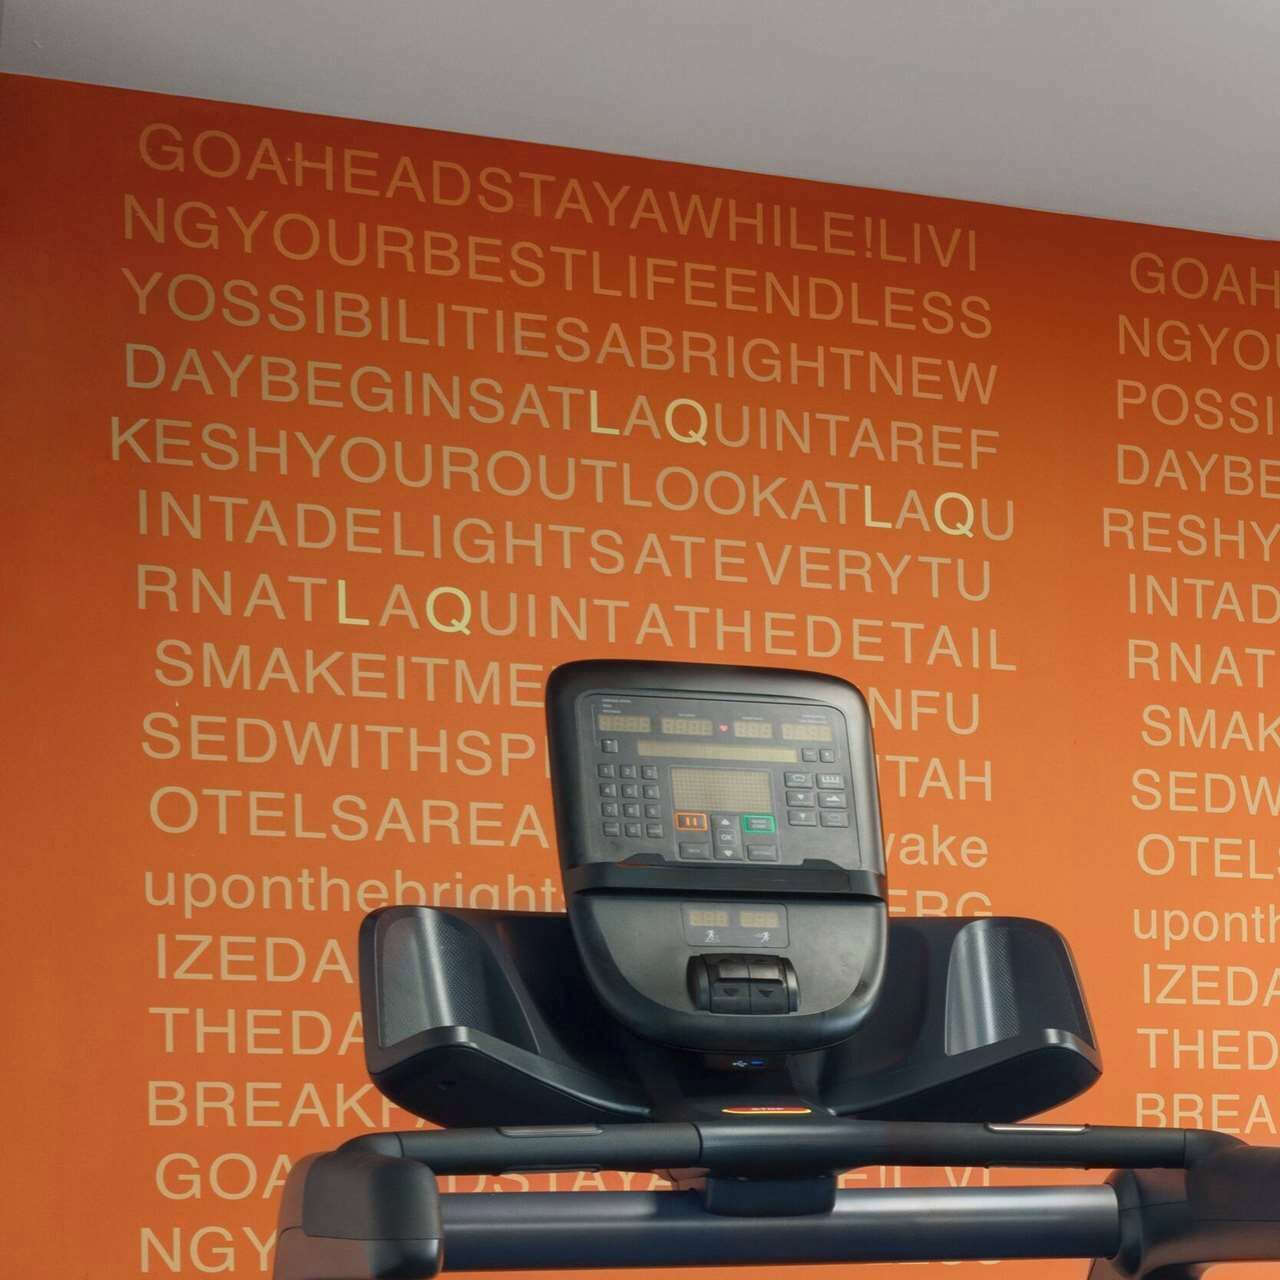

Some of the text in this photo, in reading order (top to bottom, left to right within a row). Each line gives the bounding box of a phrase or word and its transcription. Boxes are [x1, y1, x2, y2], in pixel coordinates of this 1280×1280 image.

[138, 123, 976, 271] GOAHEADSTAYAWHILE!LIVI
[124, 194, 993, 339] NGYOURBESTLIFEENDLESS
[126, 343, 1000, 470] DAYBEGINSATLAQUINTAREF
[110, 416, 1015, 541] KESHYOUROUTLOOKATLAQU
[137, 489, 991, 601] INTADELIGHTSATEVERYTU
[136, 564, 1017, 672] RNATLAQUINTATHEDETAIL
